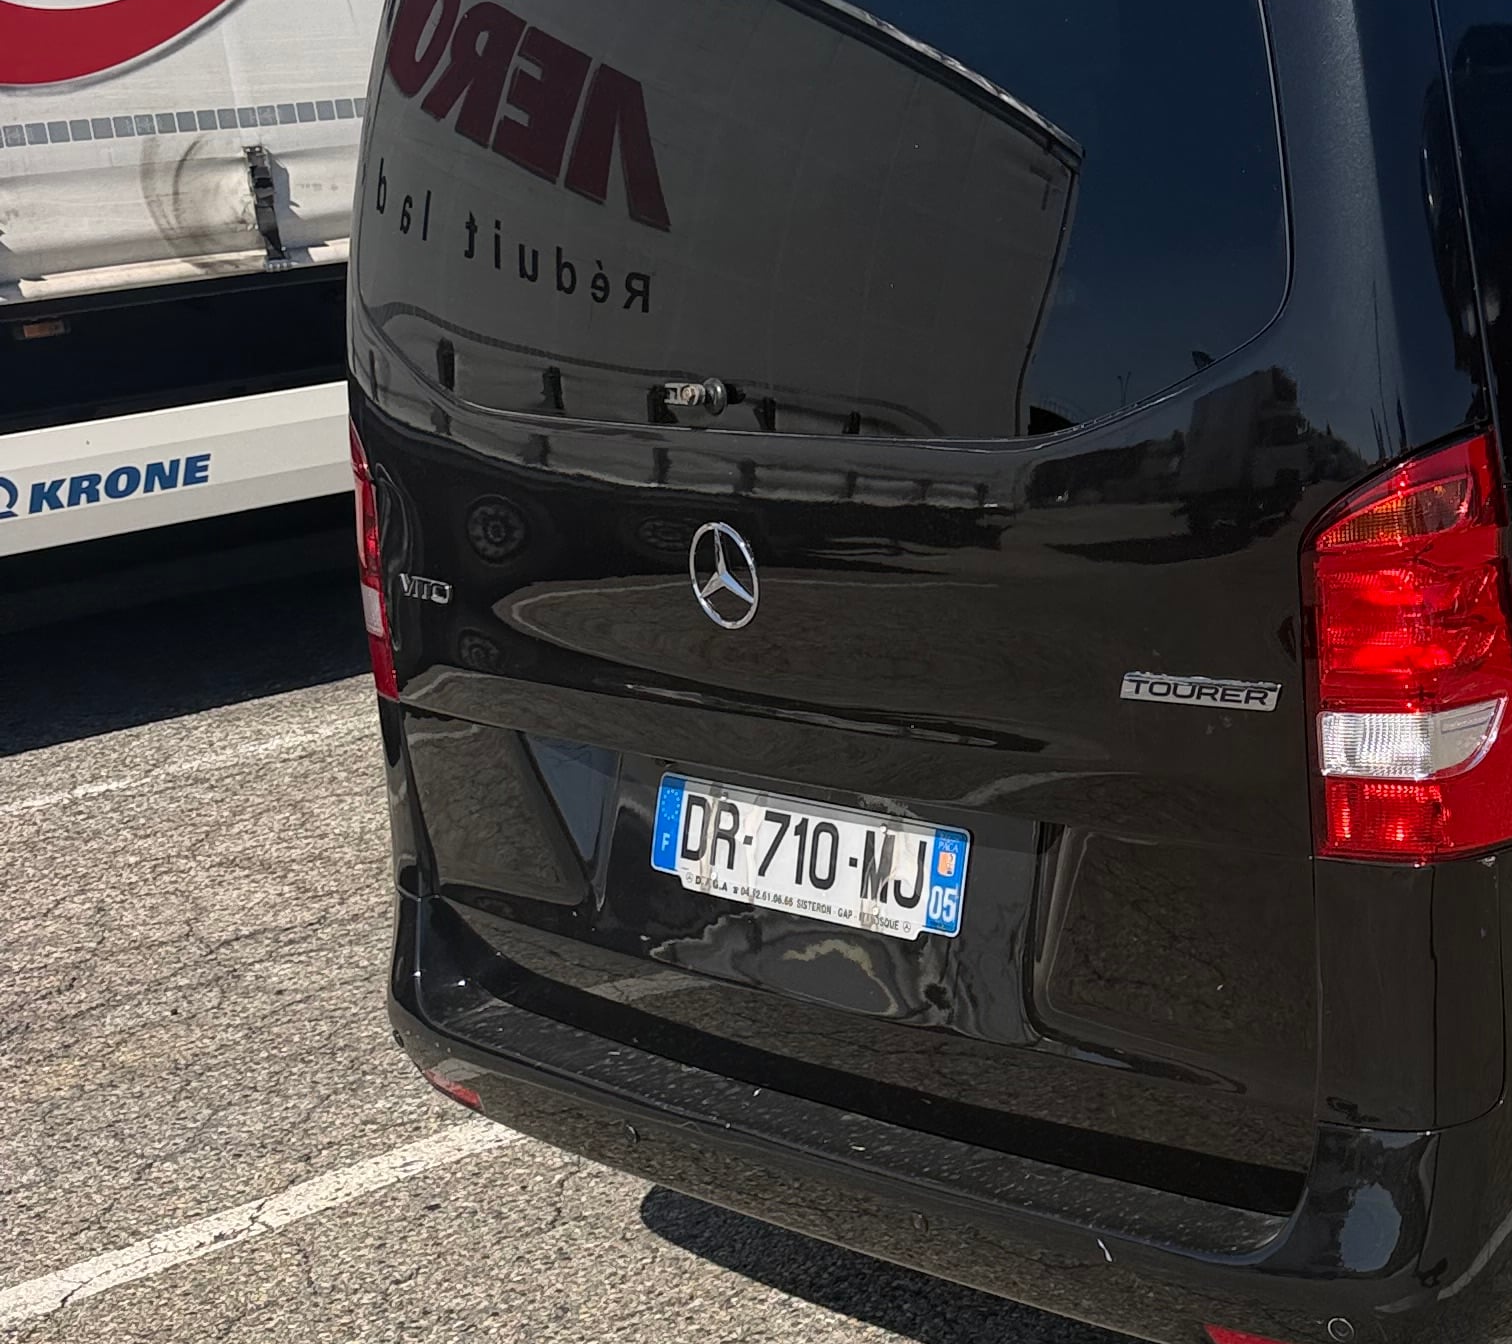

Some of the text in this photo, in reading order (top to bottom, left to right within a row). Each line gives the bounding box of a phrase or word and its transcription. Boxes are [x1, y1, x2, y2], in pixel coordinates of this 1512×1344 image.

[28, 453, 211, 514] KRONE
[399, 573, 452, 604] VITO
[1126, 678, 1270, 706] TOURER
[661, 793, 928, 909] F DR-710-MJ
[796, 898, 832, 915] SISTERON
[838, 907, 853, 919] GAP
[859, 912, 900, 931] OSQUE
[928, 885, 959, 923] 05
